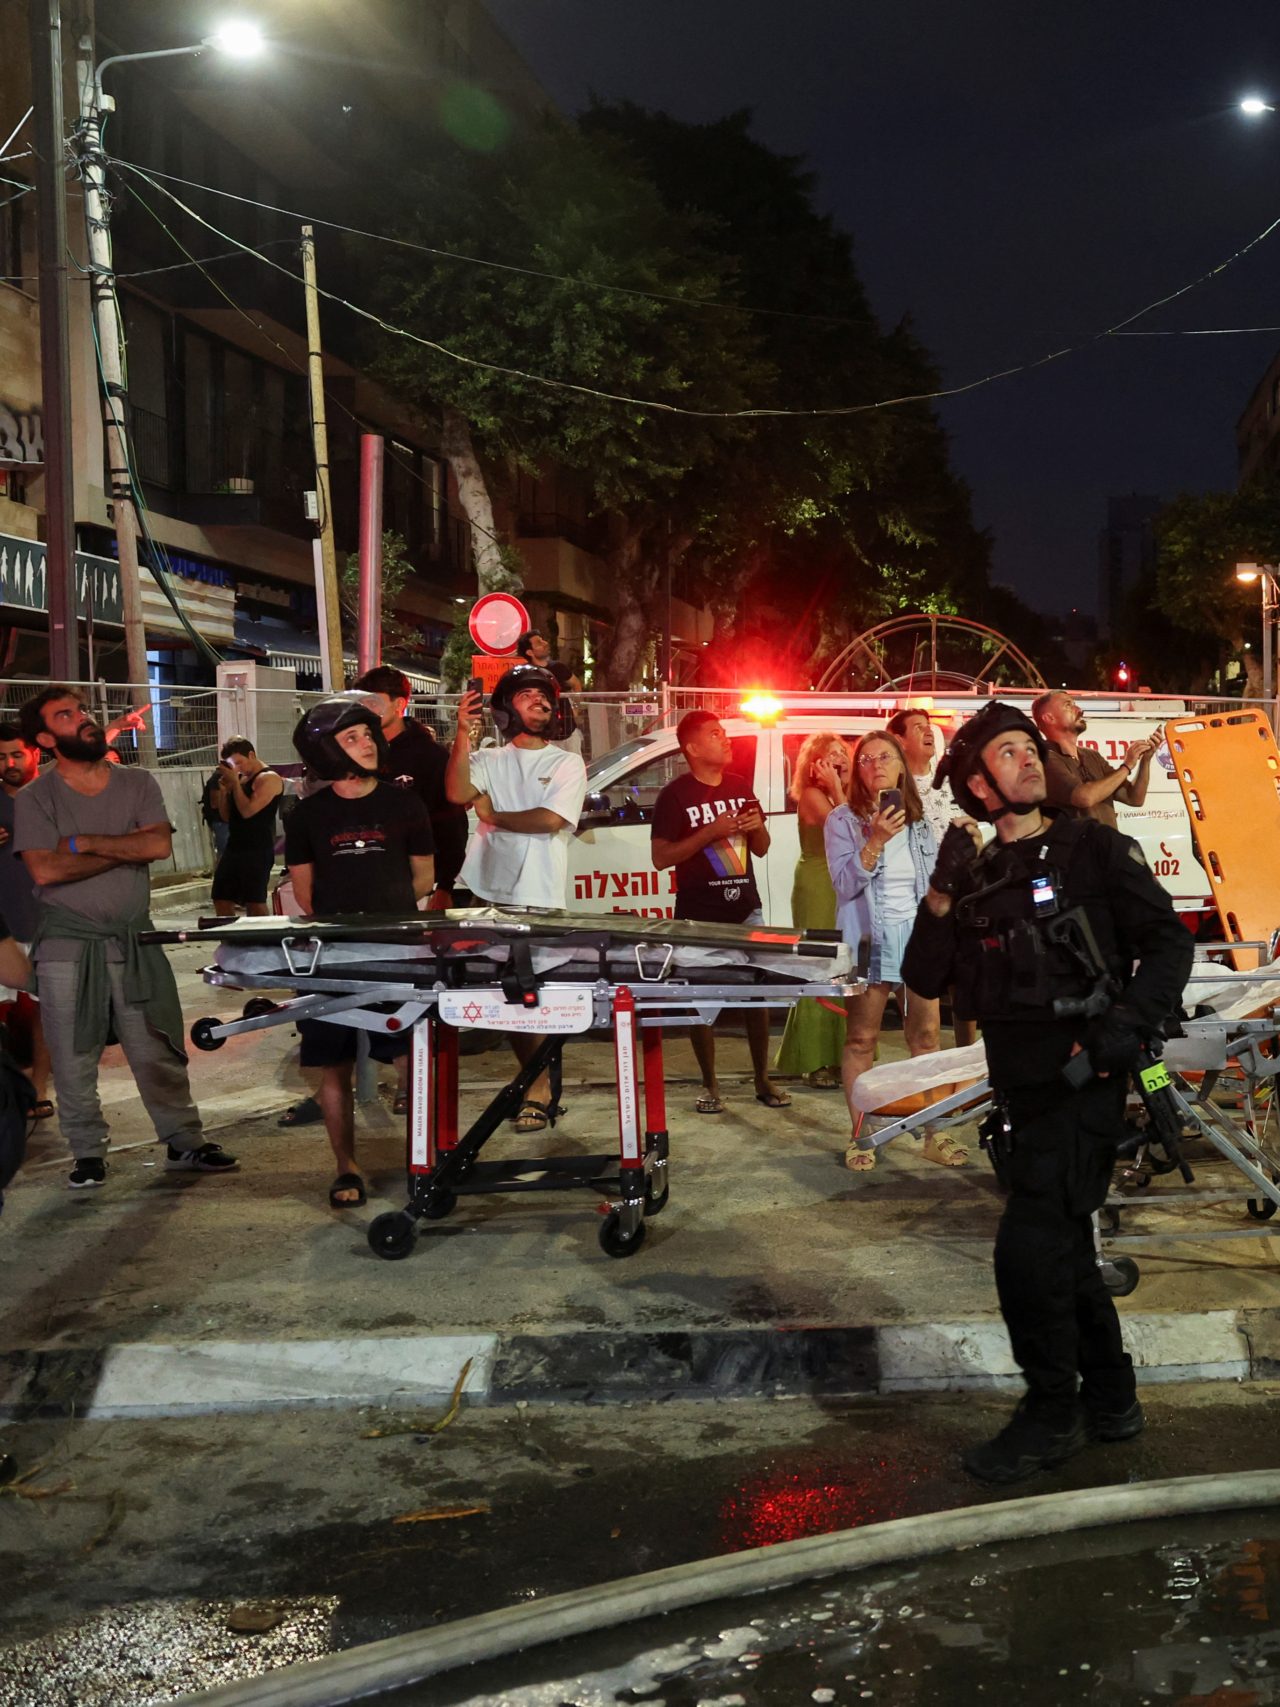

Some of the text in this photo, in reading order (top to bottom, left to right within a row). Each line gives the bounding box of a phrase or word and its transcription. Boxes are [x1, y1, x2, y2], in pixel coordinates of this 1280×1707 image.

[1124, 810, 1185, 819] www.102.gov.il
[1154, 859, 1180, 876] 102
[574, 870, 659, 900] והצלה
